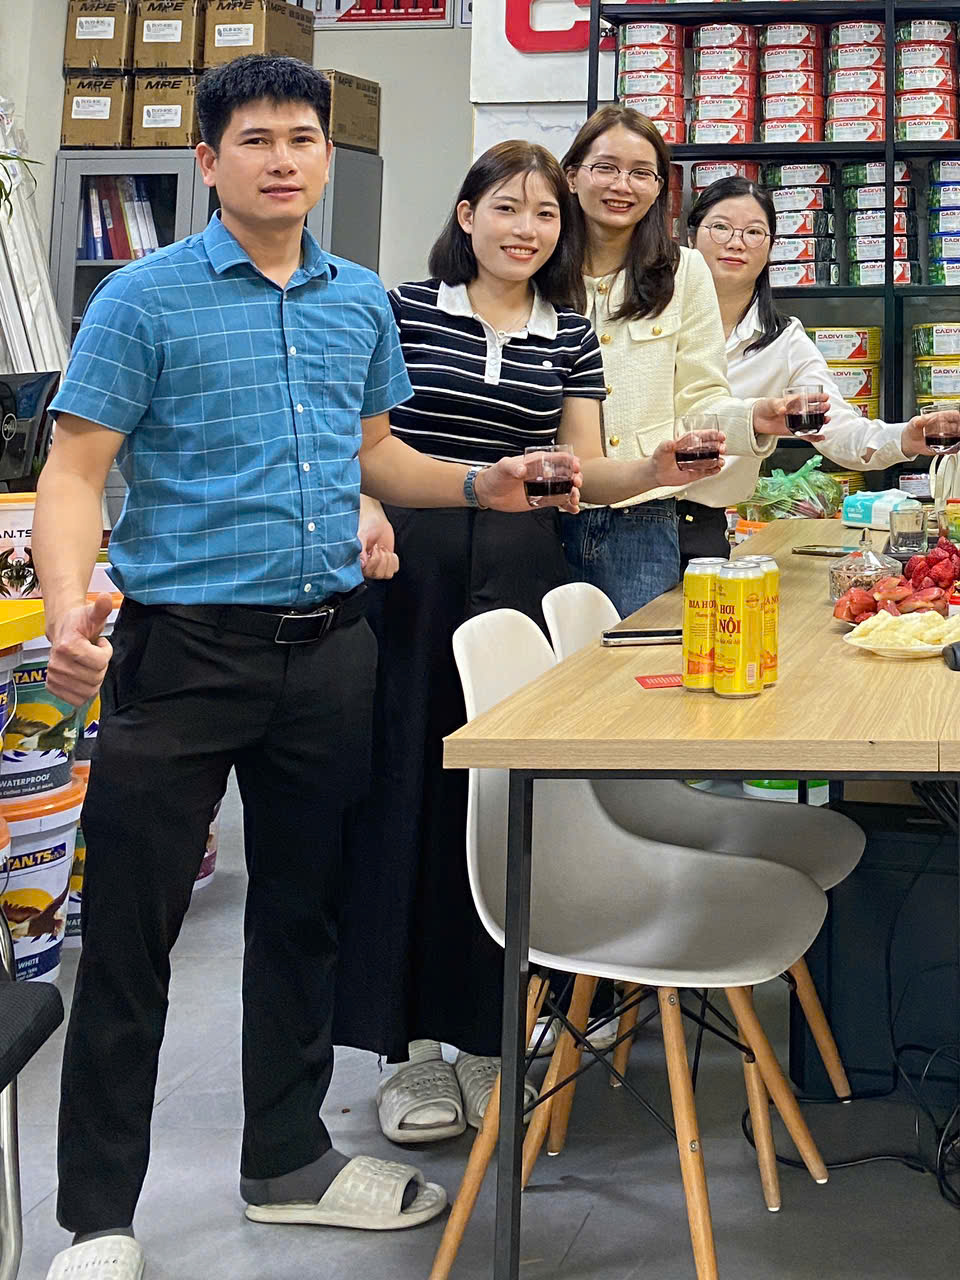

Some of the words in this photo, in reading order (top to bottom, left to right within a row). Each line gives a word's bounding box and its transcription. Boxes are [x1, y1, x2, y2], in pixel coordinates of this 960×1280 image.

[80, 3, 116, 11] MPE
[147, 2, 184, 11] MPE
[216, 0, 254, 10] MPE
[270, 3, 286, 15] MPE
[77, 81, 114, 89] MPE
[145, 81, 182, 89] MPE
[338, 76, 352, 87] MPE
[689, 600, 700, 608] BIA
[720, 605, 735, 614] HƠI
[719, 616, 741, 637] NỘI
[18, 957, 39, 969] WHITE
